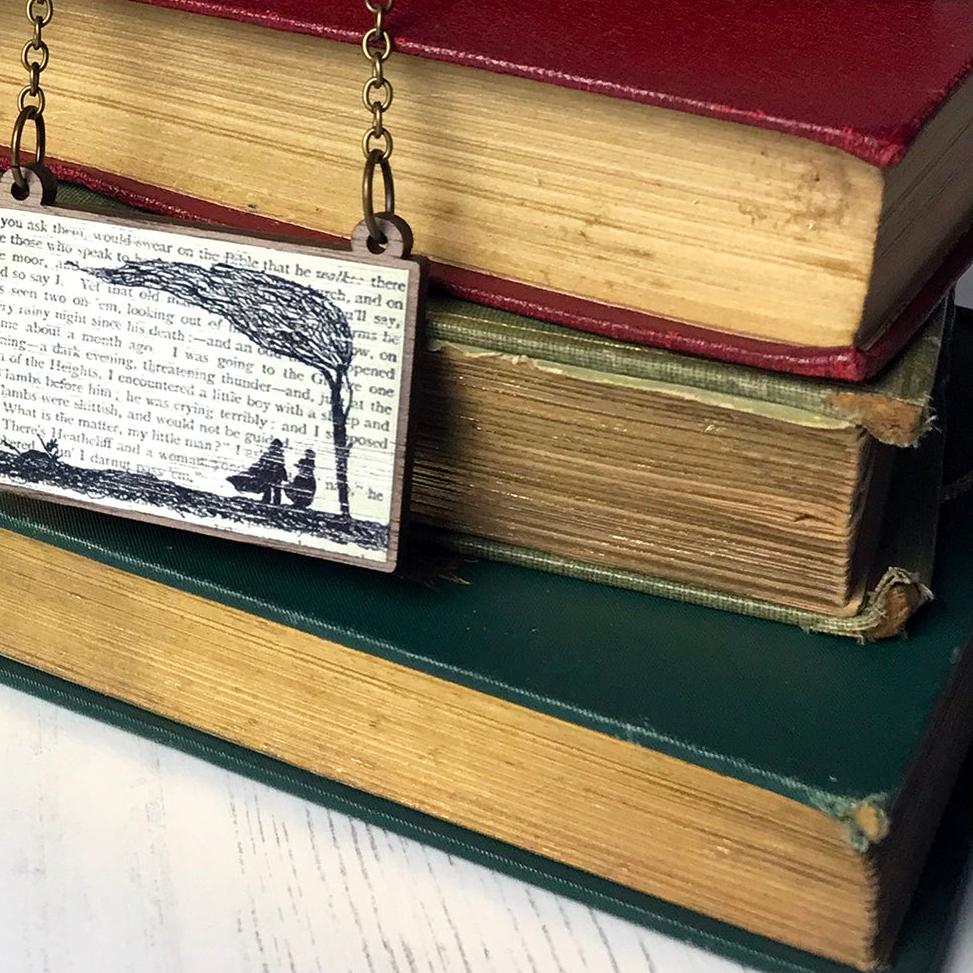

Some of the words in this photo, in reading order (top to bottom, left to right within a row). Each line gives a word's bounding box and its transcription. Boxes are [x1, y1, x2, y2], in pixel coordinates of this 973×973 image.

[0, 217, 23, 228] you
[26, 219, 48, 232] ask
[92, 233, 131, 245] would
[134, 240, 173, 253] swear
[176, 246, 194, 257] on
[198, 247, 220, 261] the
[262, 259, 290, 274] that
[295, 263, 311, 276] he
[370, 275, 406, 292] there
[10, 233, 43, 245] those
[46, 240, 73, 252] who
[76, 247, 112, 260] speak
[116, 252, 129, 265] to
[354, 293, 381, 306] and
[385, 298, 404, 310] on
[11, 253, 48, 268] moor,
[373, 315, 400, 329] say,
[12, 270, 26, 279] so
[29, 274, 49, 283] say
[107, 282, 133, 297] that
[138, 289, 159, 301] old
[0, 320, 18, 328] me
[25, 321, 60, 336] about
[81, 333, 121, 347] month
[184, 351, 208, 362] was
[217, 357, 254, 370] going
[261, 364, 275, 374] to
[283, 367, 304, 379] the
[368, 385, 395, 397] one
[10, 288, 37, 298] seen
[43, 292, 66, 303] two
[72, 297, 90, 306] on
[127, 303, 174, 324] looking
[180, 316, 201, 326] out
[207, 318, 223, 327] of
[379, 351, 397, 362] on
[18, 307, 50, 320] rainy
[54, 311, 87, 323] night
[91, 318, 122, 327] since
[126, 320, 144, 333] his
[234, 343, 252, 353] an
[0, 383, 37, 400] lambs
[41, 395, 69, 405] were
[73, 399, 122, 418] skittish,
[127, 411, 151, 422] and
[156, 416, 194, 429] would
[199, 424, 219, 434] not
[224, 425, 240, 436] be
[5, 368, 41, 384] lambs
[45, 375, 83, 389] before
[126, 390, 141, 402] he
[145, 397, 169, 406] was
[173, 404, 213, 418] crying
[281, 423, 306, 434] and
[9, 353, 22, 363] of
[25, 356, 45, 368] the
[49, 358, 102, 376] Heights,
[117, 375, 194, 395] encountered
[212, 389, 242, 403] little
[246, 395, 270, 412] boy
[274, 403, 303, 416] with
[363, 419, 389, 431] and
[51, 342, 80, 357] dark
[85, 352, 137, 369] evening,
[142, 359, 215, 384] threatening
[370, 400, 393, 415] the
[41, 412, 51, 420] is
[55, 411, 74, 424] the
[78, 418, 122, 435] matter,
[127, 428, 147, 441] my
[151, 429, 180, 444] little
[50, 426, 113, 448] Heathcliff
[116, 443, 140, 454] and
[367, 487, 383, 501] he
[89, 453, 130, 471] darnut
